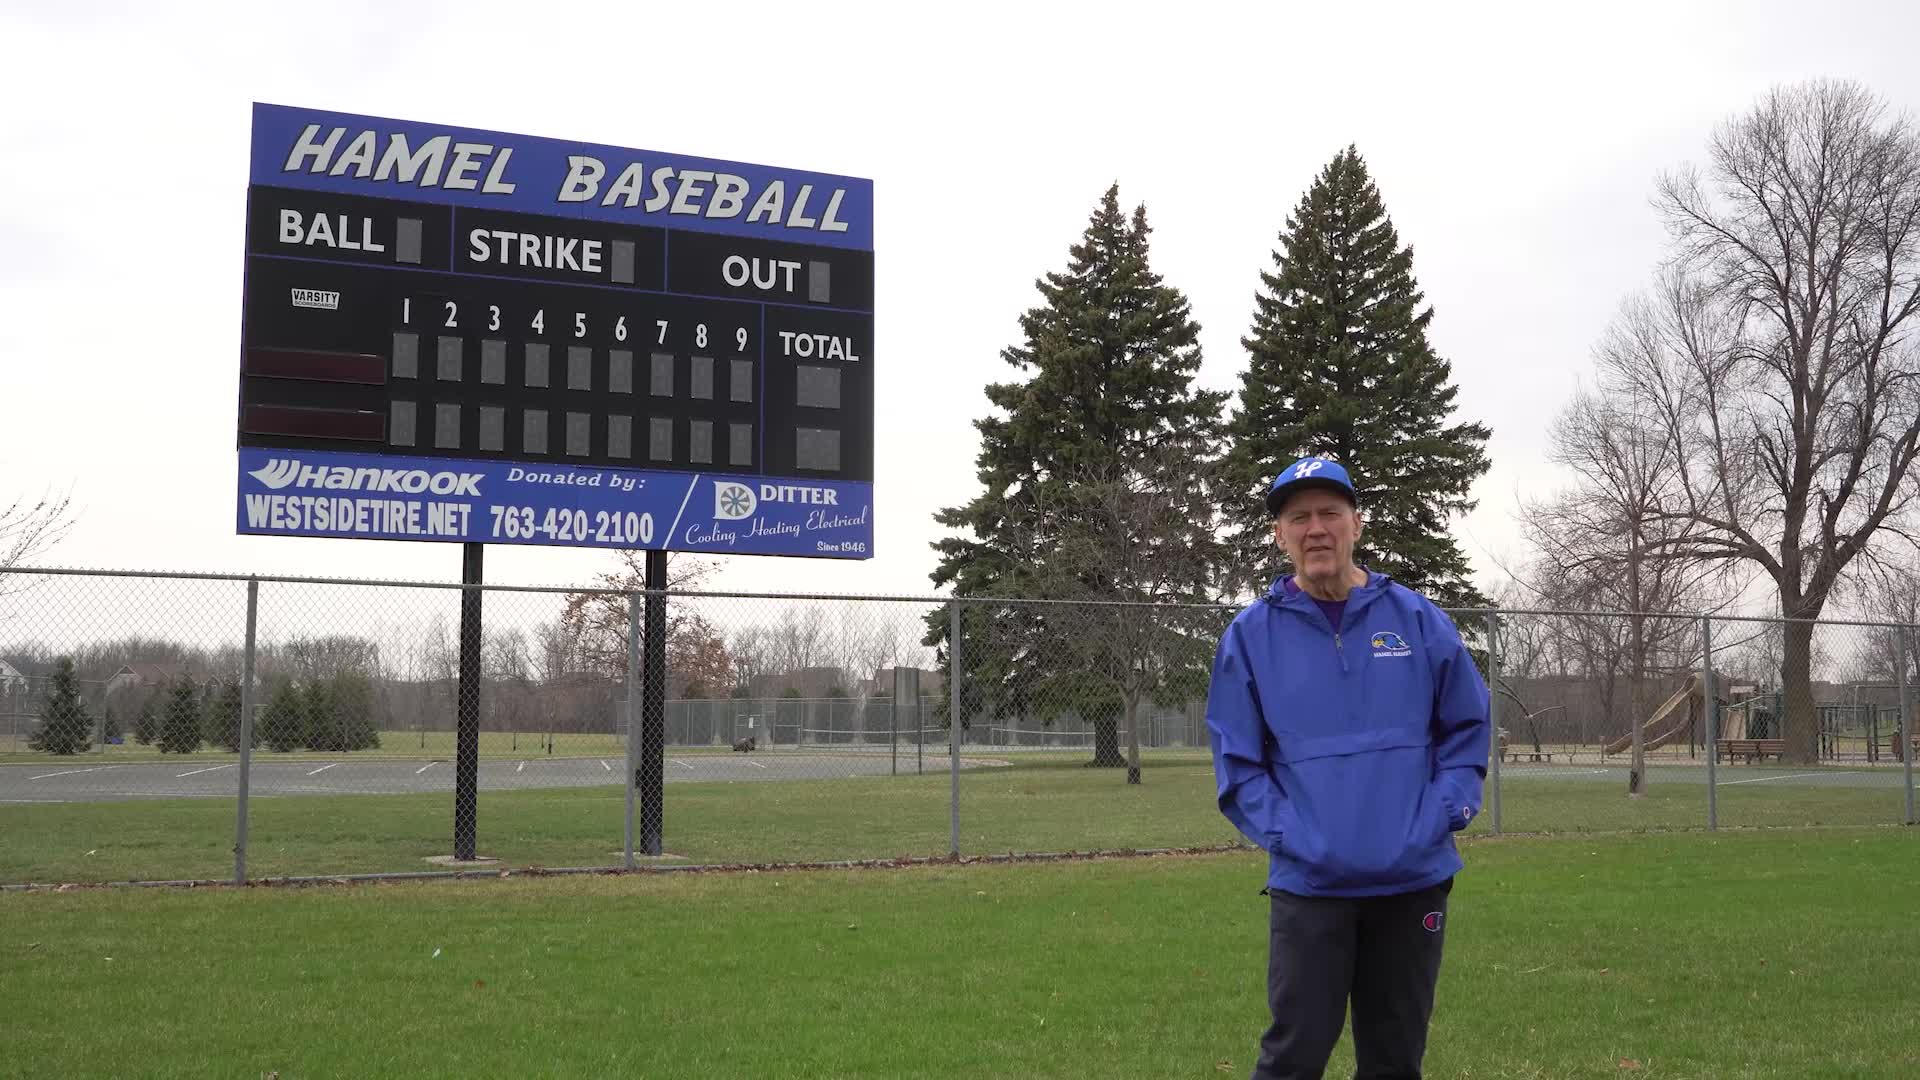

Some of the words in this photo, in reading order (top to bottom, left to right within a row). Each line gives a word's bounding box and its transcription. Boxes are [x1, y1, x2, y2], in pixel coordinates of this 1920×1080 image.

[283, 124, 518, 194] HAMEL
[558, 155, 849, 232] BASEBALL
[279, 209, 385, 252] BALL
[469, 228, 602, 273] STRIKE
[722, 255, 801, 292] OUT
[293, 290, 338, 304] VARSITY
[403, 298, 410, 323] 1
[444, 301, 458, 328] 2
[488, 305, 500, 331] 3
[531, 309, 544, 334] 4
[575, 312, 586, 338] 5
[615, 316, 627, 341] 6
[656, 320, 668, 345] 7
[695, 323, 708, 349] 8
[736, 327, 747, 351] 9
[779, 331, 860, 362] TOTAL
[507, 468, 602, 487] Donated
[609, 474, 646, 492] by:
[760, 484, 839, 505] DITTER
[245, 494, 471, 537] WESTSIDETIRE.NET
[490, 505, 654, 544] 763-420-2100
[685, 522, 736, 545] Cooling
[742, 516, 800, 537] Heating
[806, 505, 868, 530] Electrical
[816, 540, 839, 552] Since
[841, 541, 866, 553] 1946
